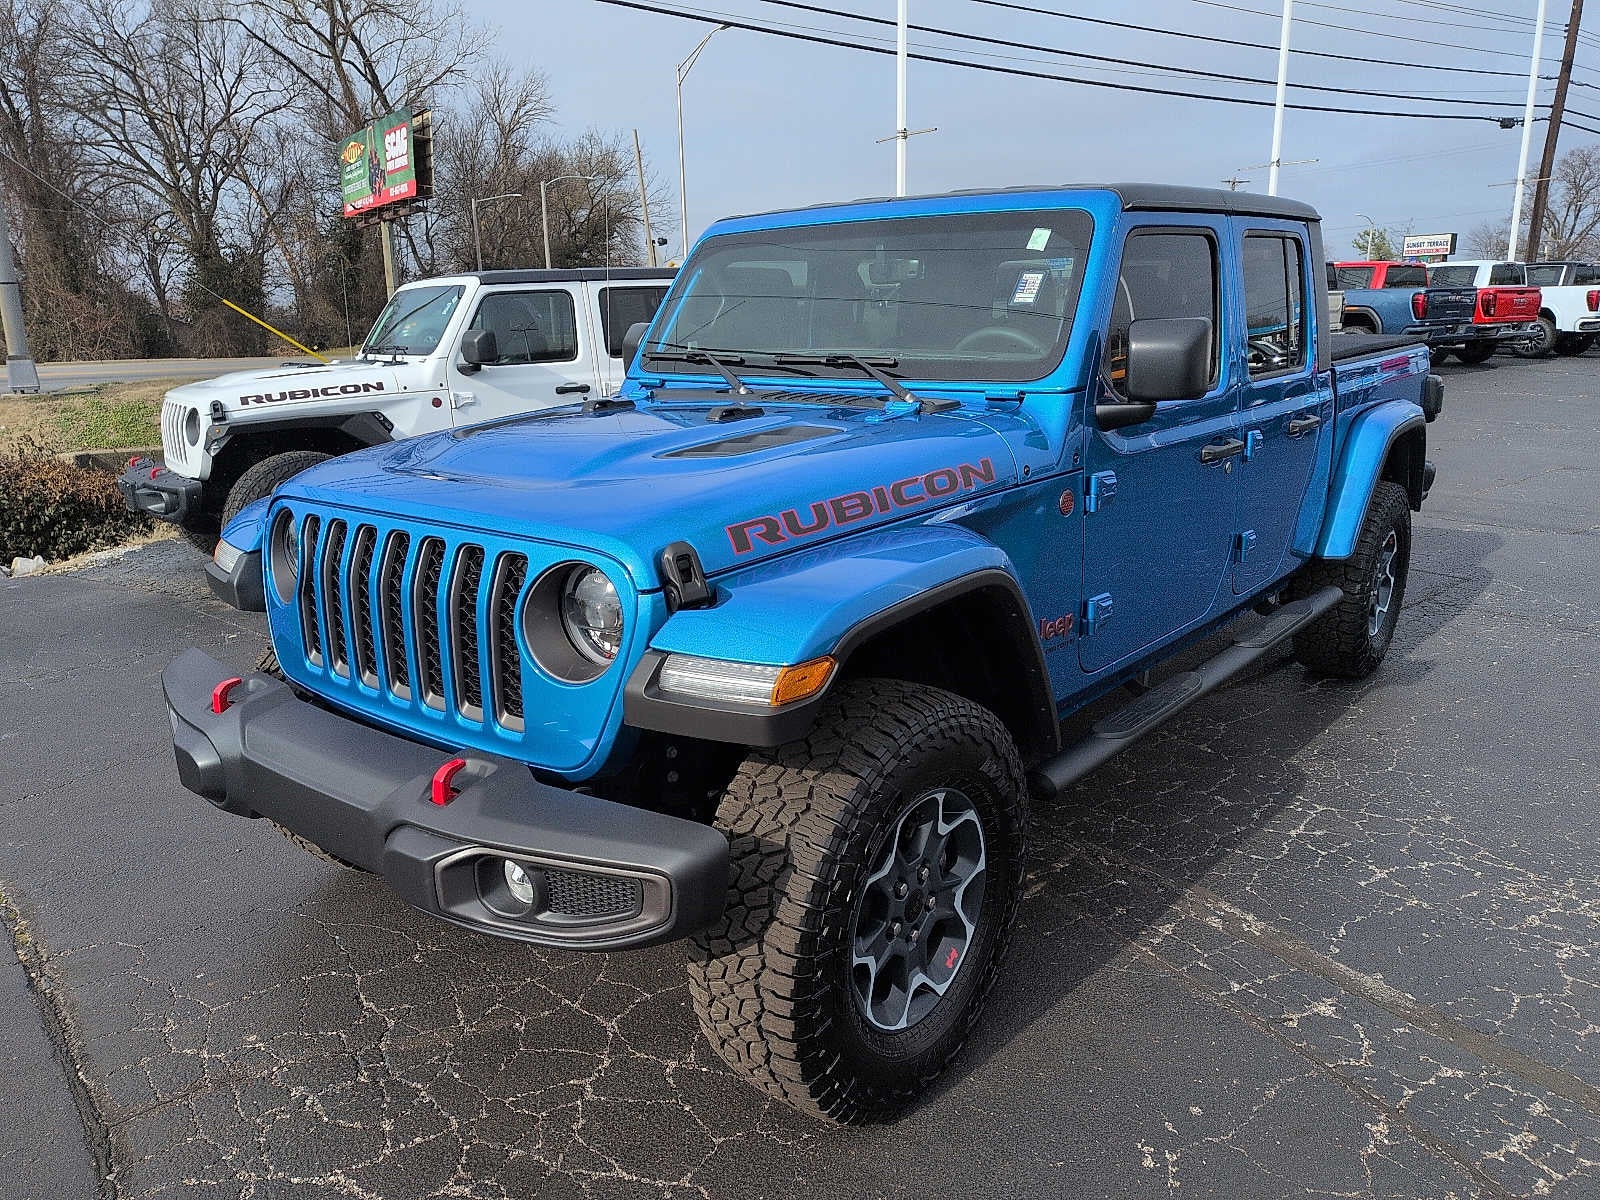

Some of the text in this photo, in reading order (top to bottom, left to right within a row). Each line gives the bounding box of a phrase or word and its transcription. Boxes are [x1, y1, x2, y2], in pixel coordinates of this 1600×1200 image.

[1406, 240, 1449, 249] SUNSET TERRACE
[239, 381, 385, 406] RUBICON
[725, 457, 997, 556] RUBICON
[1039, 612, 1073, 639] Jeep
